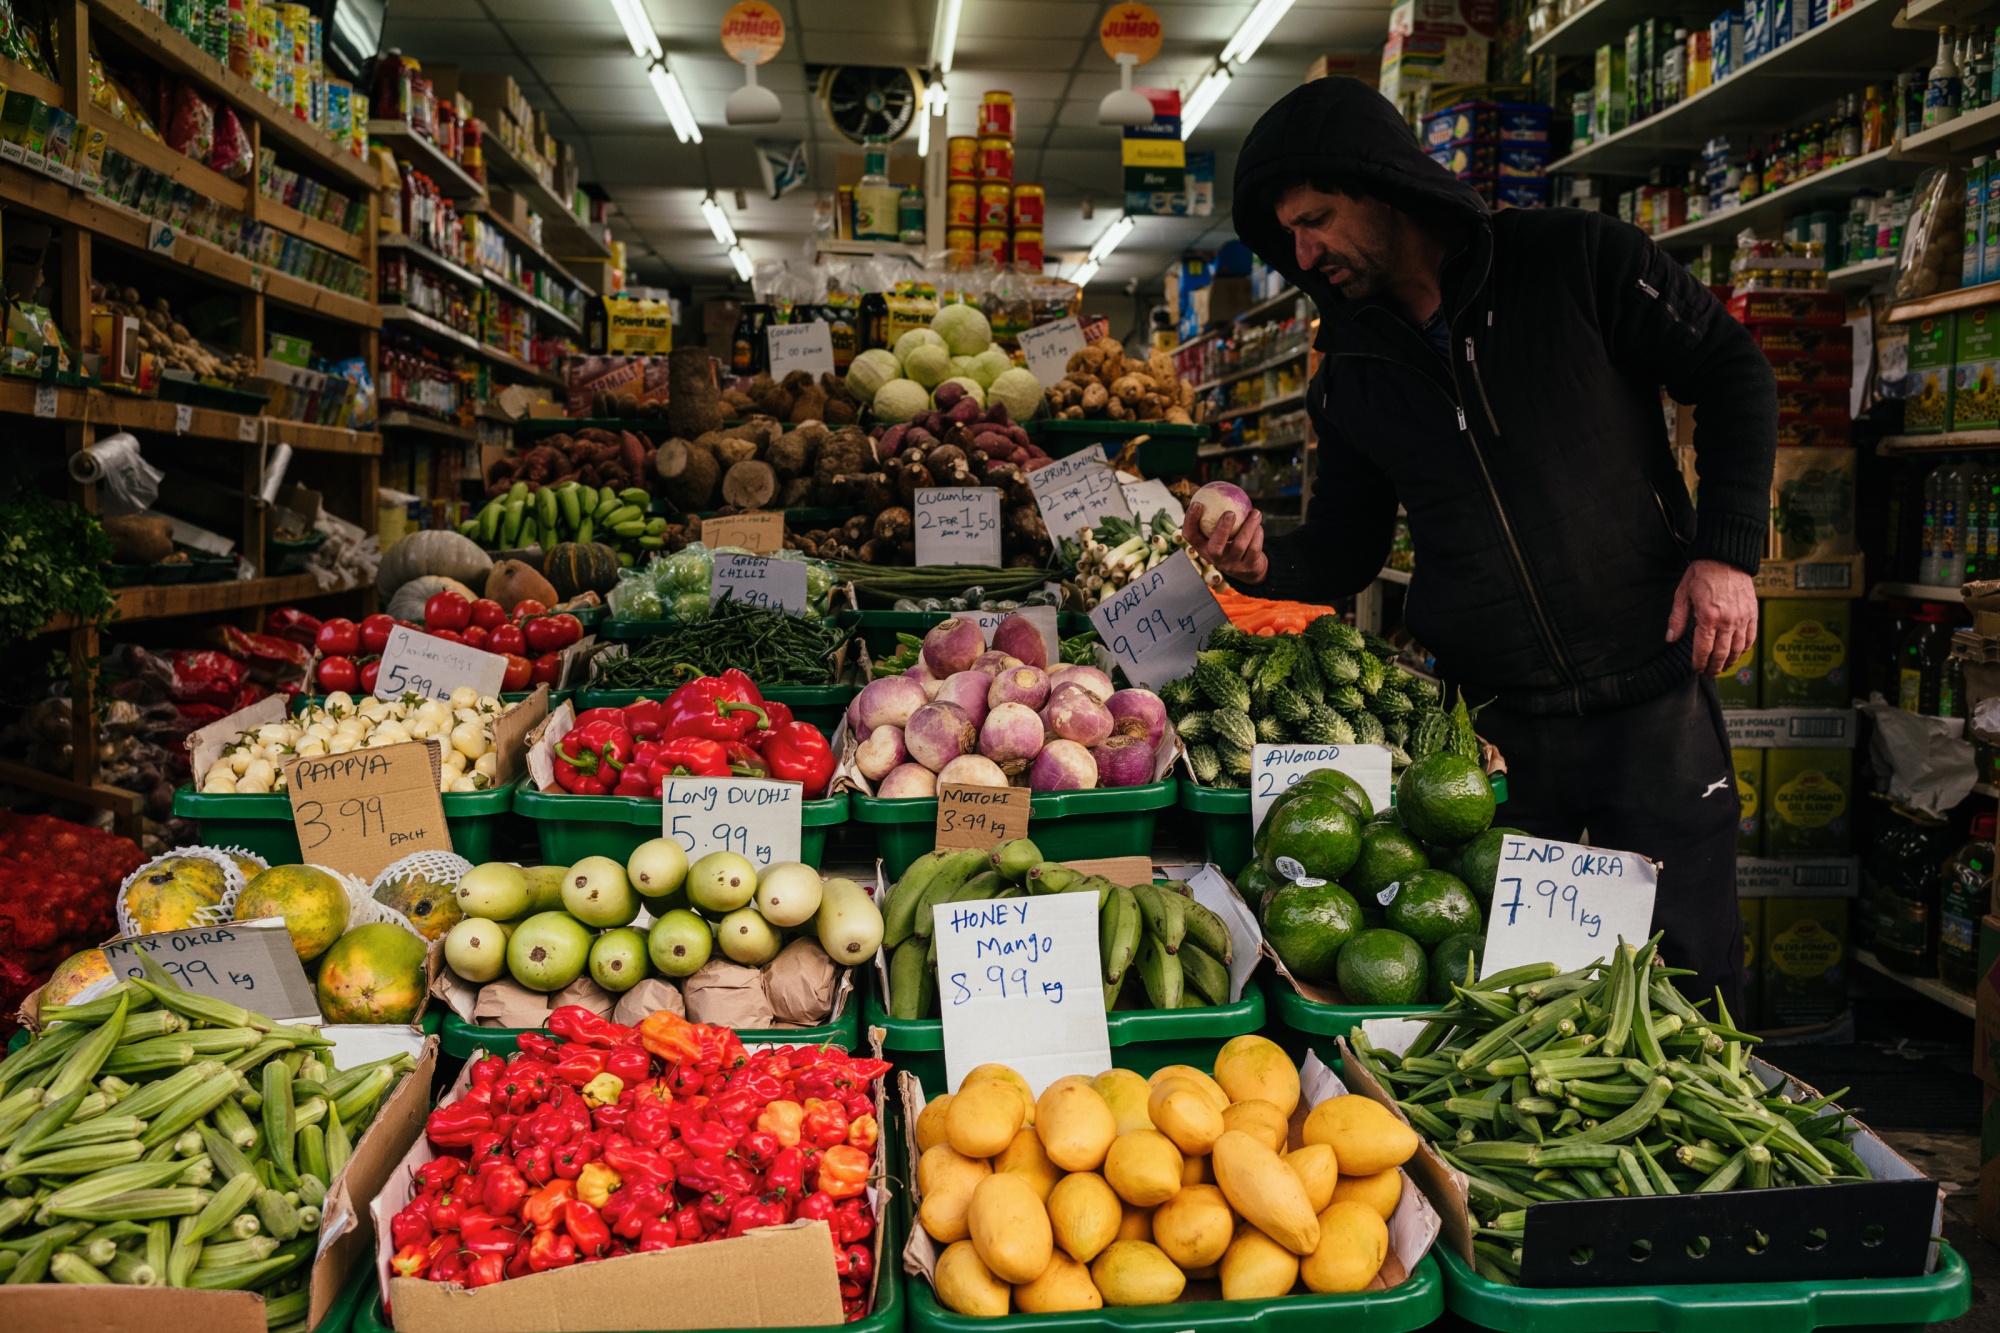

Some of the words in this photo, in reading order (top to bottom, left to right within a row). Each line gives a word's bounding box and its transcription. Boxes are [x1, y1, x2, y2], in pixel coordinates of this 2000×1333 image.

[723, 20, 781, 35] JUMBO
[1103, 22, 1161, 38] JUMBO
[613, 315, 644, 328] Power
[646, 317, 666, 329] Malt
[893, 311, 920, 323] Power
[590, 365, 639, 395] ERMALT
[1040, 494, 1060, 511] 2
[1062, 488, 1081, 501] FOR
[918, 511, 937, 529] 2
[938, 516, 959, 527] FOR
[719, 568, 766, 579] CHILLI
[732, 555, 769, 567] GREEN
[719, 585, 768, 608] 799
[1113, 609, 1171, 664] 9.99
[1178, 615, 1196, 634] kg
[384, 664, 432, 697] 5.99
[1726, 718, 1786, 727] LIVE-POMACE
[296, 754, 393, 790] PAPPYA
[296, 796, 385, 848] 3.99
[389, 828, 427, 847] EACH
[941, 809, 987, 832] 3.99
[990, 820, 1006, 839] kg
[672, 815, 748, 855] 5.99
[756, 845, 772, 864] kg
[1504, 841, 1565, 863] IND
[1572, 853, 1624, 878] OKRA
[950, 901, 1028, 933] HONEY
[1500, 877, 1579, 926] 7.99
[1580, 908, 1602, 938] kg
[172, 929, 236, 952] OKRA
[977, 933, 1053, 963] Mango
[228, 971, 255, 990] kg
[950, 965, 1029, 1005] 8.99
[1042, 981, 1064, 1004] kg
